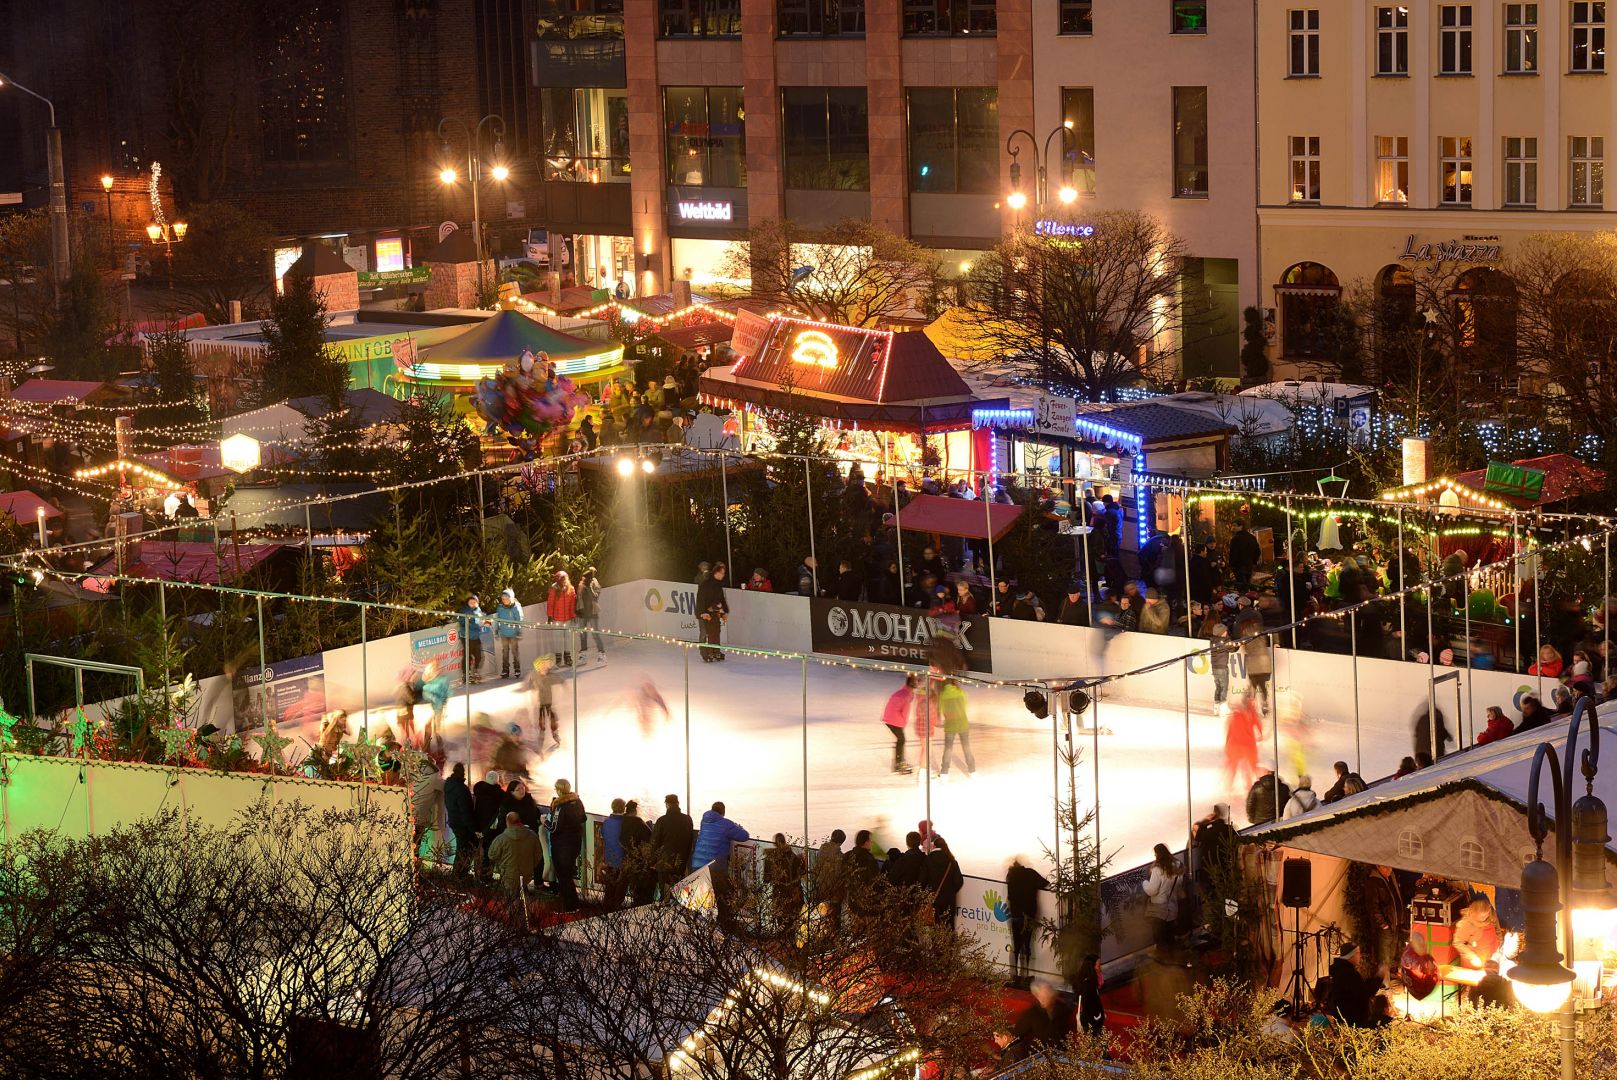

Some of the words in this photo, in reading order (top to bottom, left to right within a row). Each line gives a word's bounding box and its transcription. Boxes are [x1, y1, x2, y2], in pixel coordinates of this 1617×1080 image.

[679, 202, 731, 220] Weltbild
[1035, 221, 1094, 236] Silence
[1399, 234, 1431, 261] La
[1337, 400, 1346, 416] P
[664, 590, 697, 616] StW
[880, 644, 927, 660] STORE
[955, 906, 991, 922] reativ
